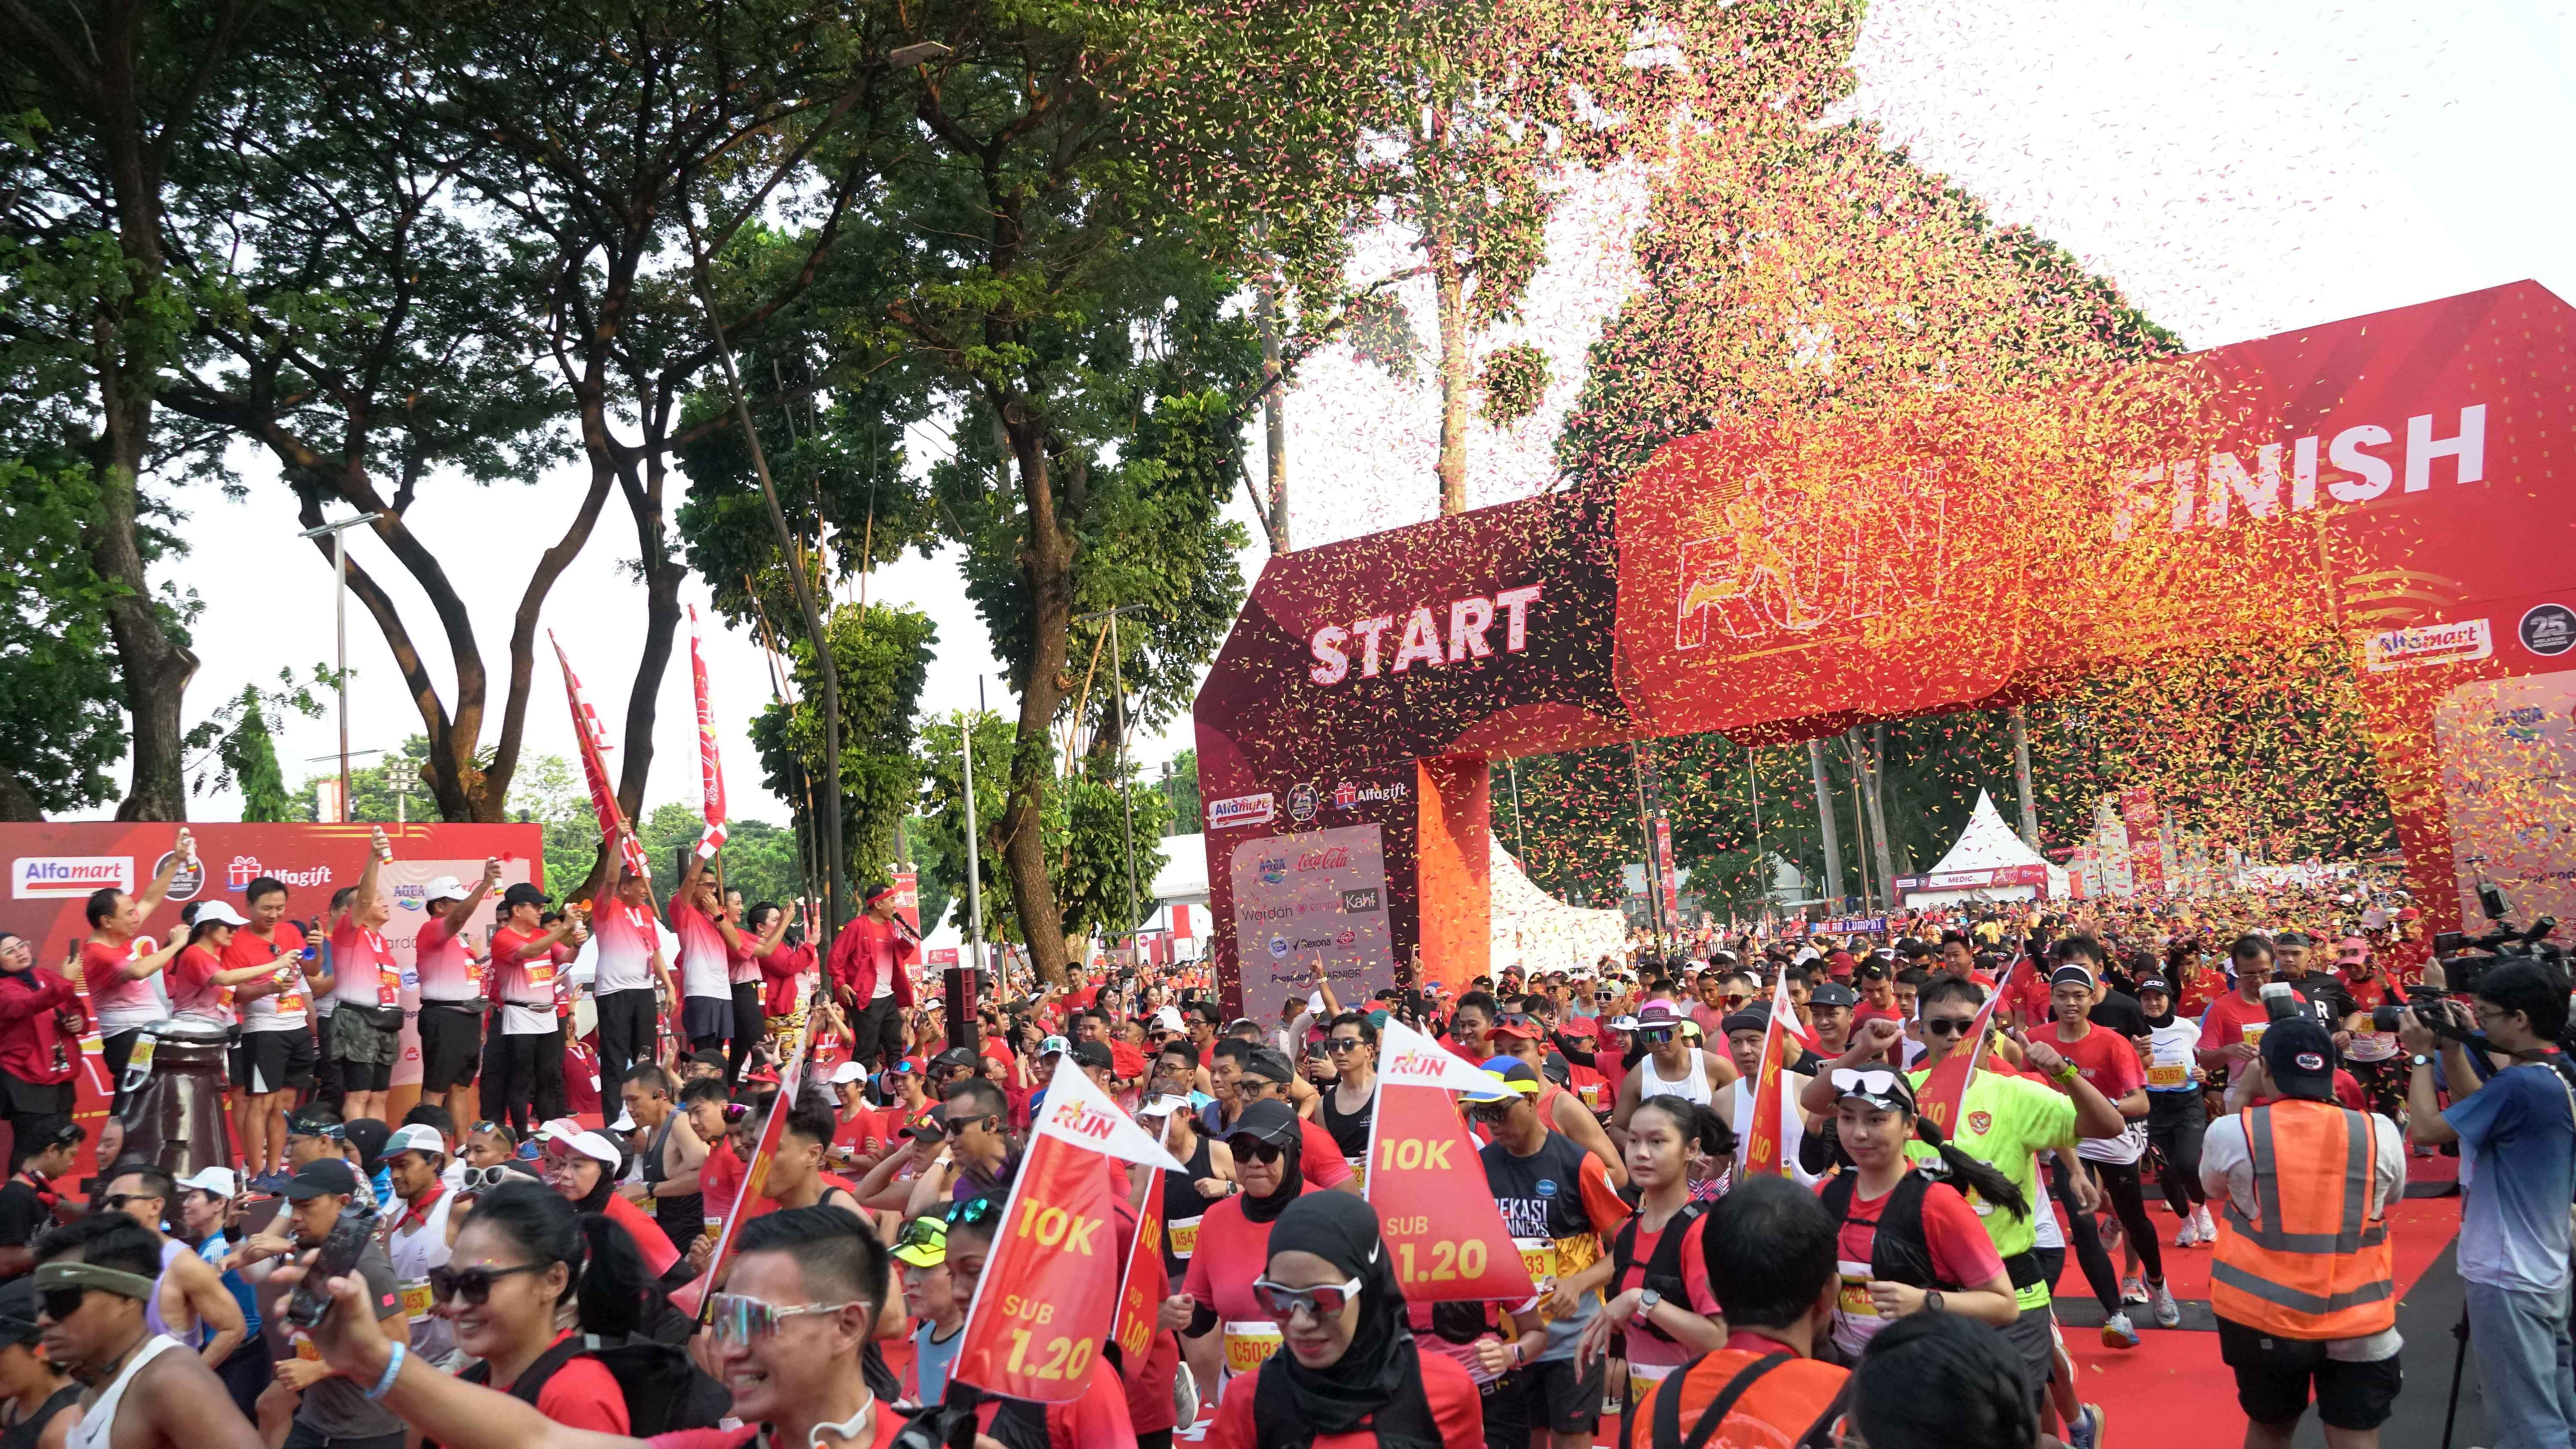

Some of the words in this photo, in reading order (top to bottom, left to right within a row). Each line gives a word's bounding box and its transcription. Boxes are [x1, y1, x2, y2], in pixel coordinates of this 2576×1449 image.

[2111, 403, 2486, 540] FINISH
[1309, 585, 1542, 685] START
[2530, 613, 2569, 638] 25
[1293, 791, 1312, 808] 25
[1358, 782, 1406, 801] Alfagift
[1216, 799, 1269, 815] Alfamart
[26, 862, 122, 879] Alfamart
[1259, 858, 1286, 872] AQUA
[261, 866, 332, 887] Alfagift
[394, 885, 425, 897] AQUA
[1346, 892, 1376, 909] Kahf
[1242, 906, 1293, 921] Wardah
[1846, 919, 1881, 931] LUMPAT
[1301, 938, 1331, 949] Rexona
[532, 968, 552, 978] B1352
[1643, 1009, 1666, 1018] 2XU
[1950, 1036, 1979, 1059] 10K
[1390, 1055, 1447, 1076] RUN
[2153, 1069, 2181, 1080] A5162
[1052, 1104, 1116, 1140] RUN
[1381, 1139, 1457, 1171] 10K
[1018, 1197, 1104, 1256] 10K
[1386, 1216, 1429, 1237] SUB
[1505, 1219, 1550, 1237] NNERS
[1399, 1239, 1488, 1283] 1.20
[1518, 1251, 1545, 1274] 33
[1129, 1286, 1143, 1309] SUB
[1003, 1294, 1054, 1325] SUB
[1122, 1310, 1150, 1358] 1.00
[1006, 1327, 1093, 1381] 1.20
